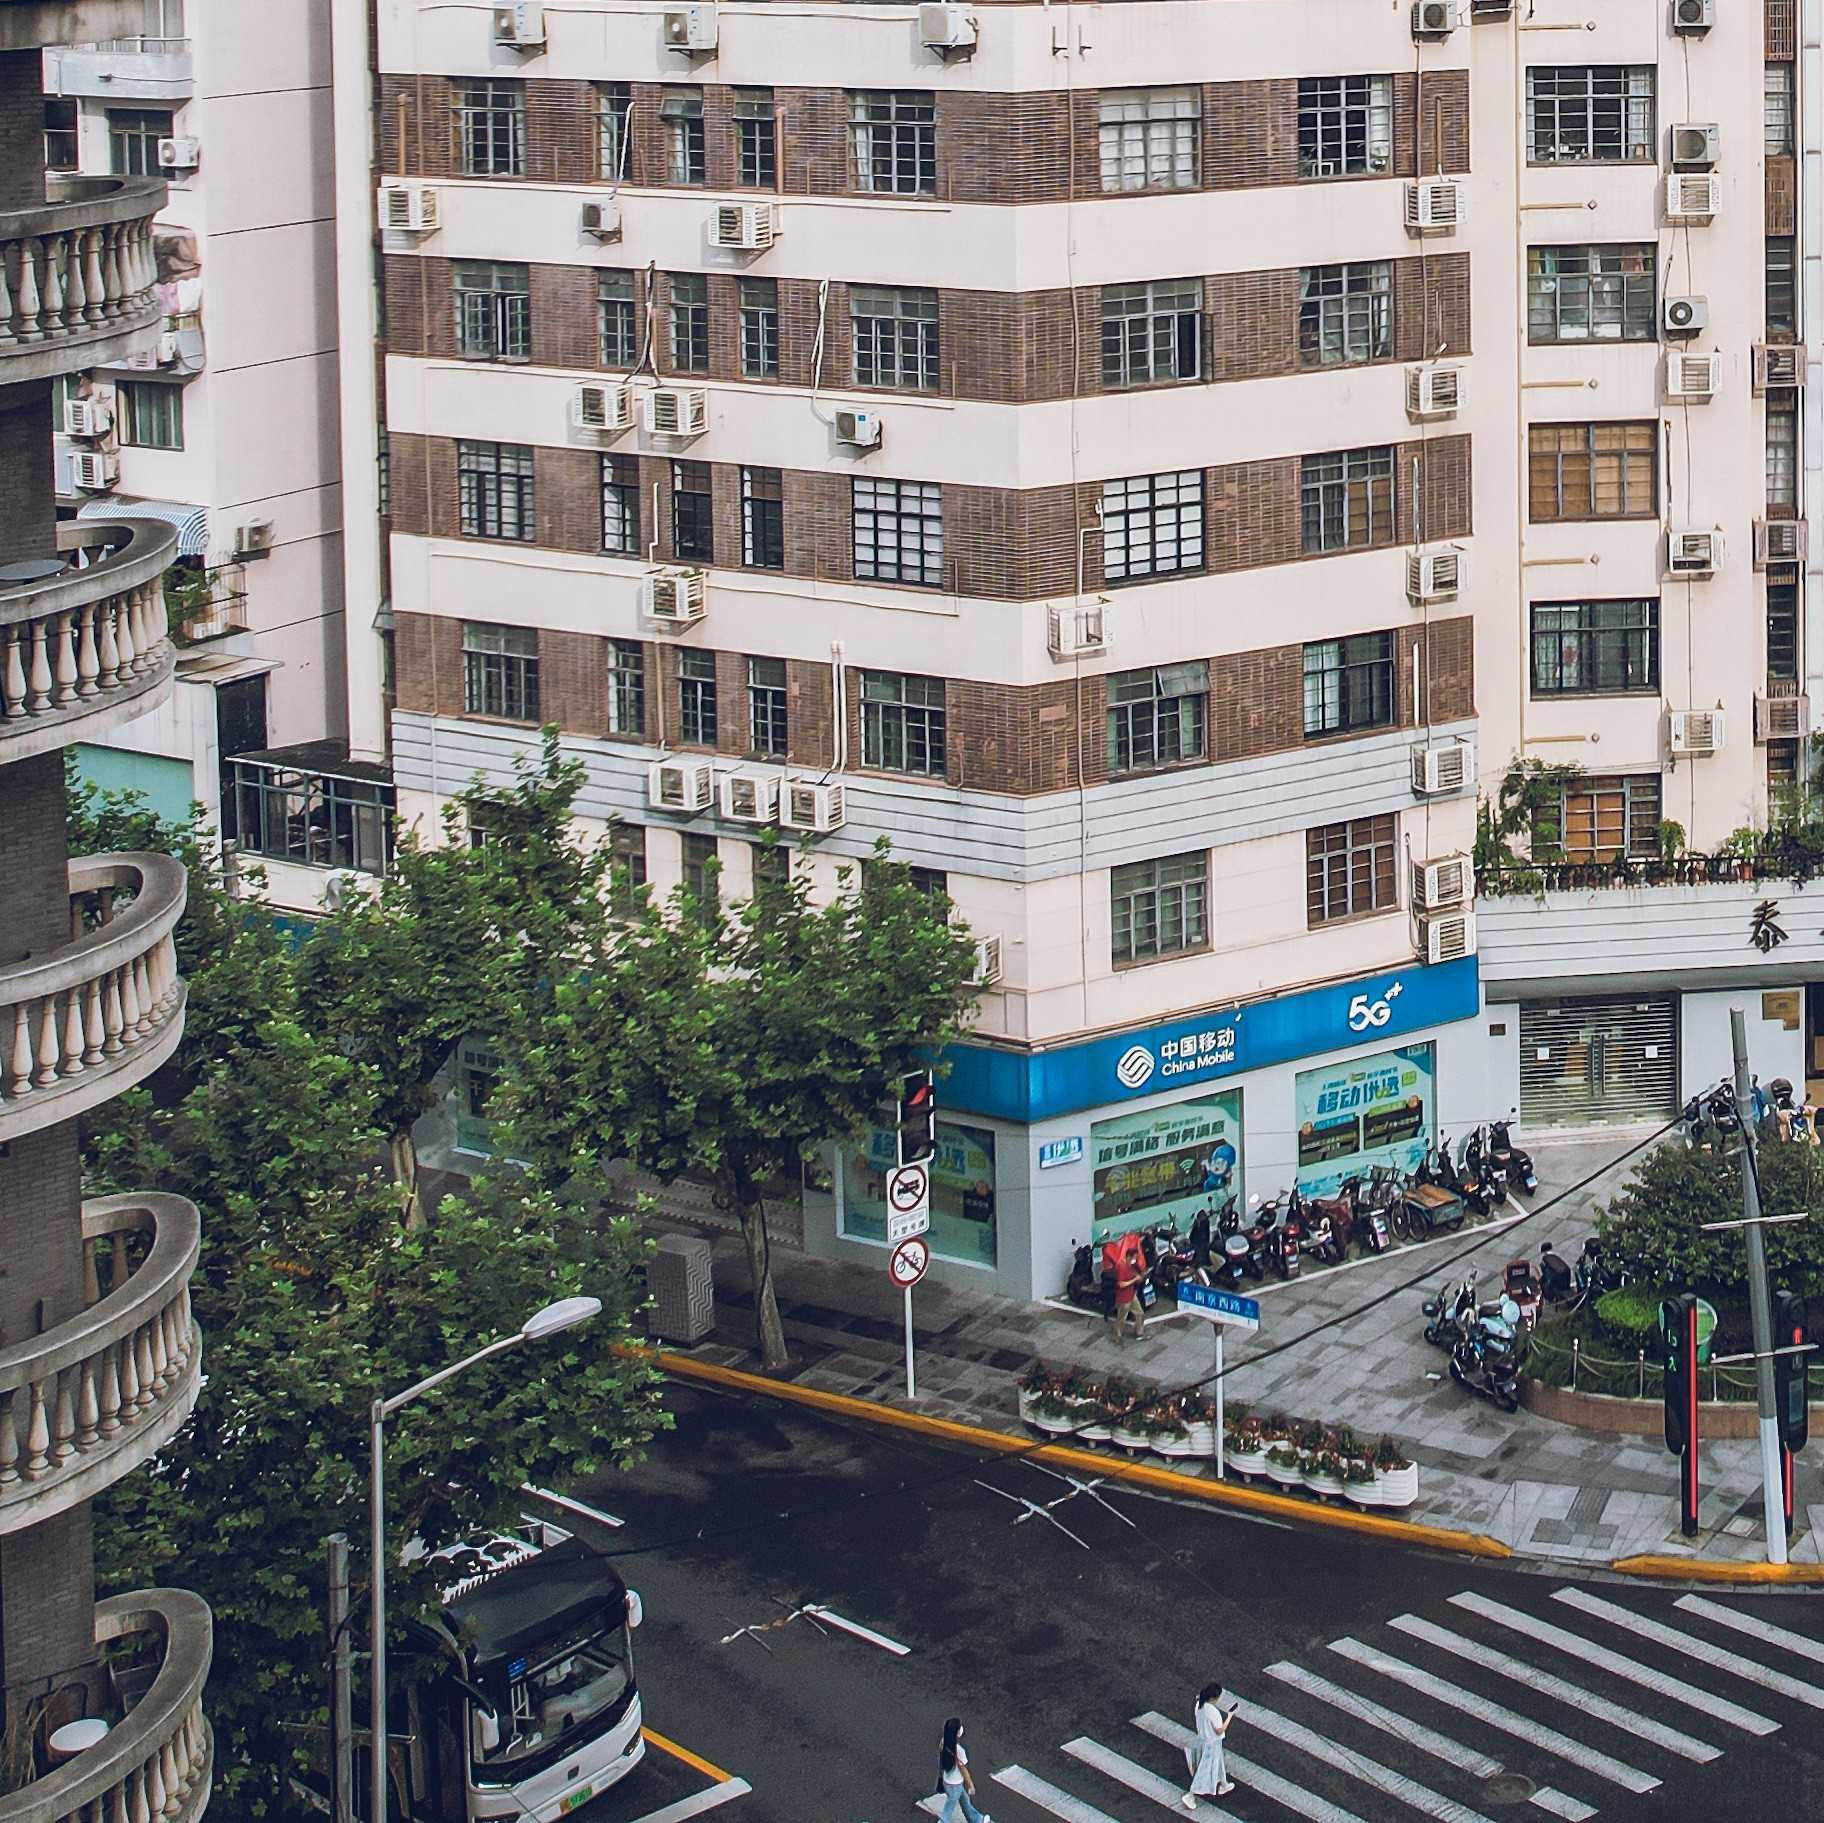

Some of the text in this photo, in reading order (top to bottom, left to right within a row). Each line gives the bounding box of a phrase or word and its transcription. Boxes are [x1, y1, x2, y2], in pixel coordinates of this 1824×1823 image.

[1160, 1027, 1235, 1060] 中国移动
[1161, 1049, 1235, 1076] China Mobile
